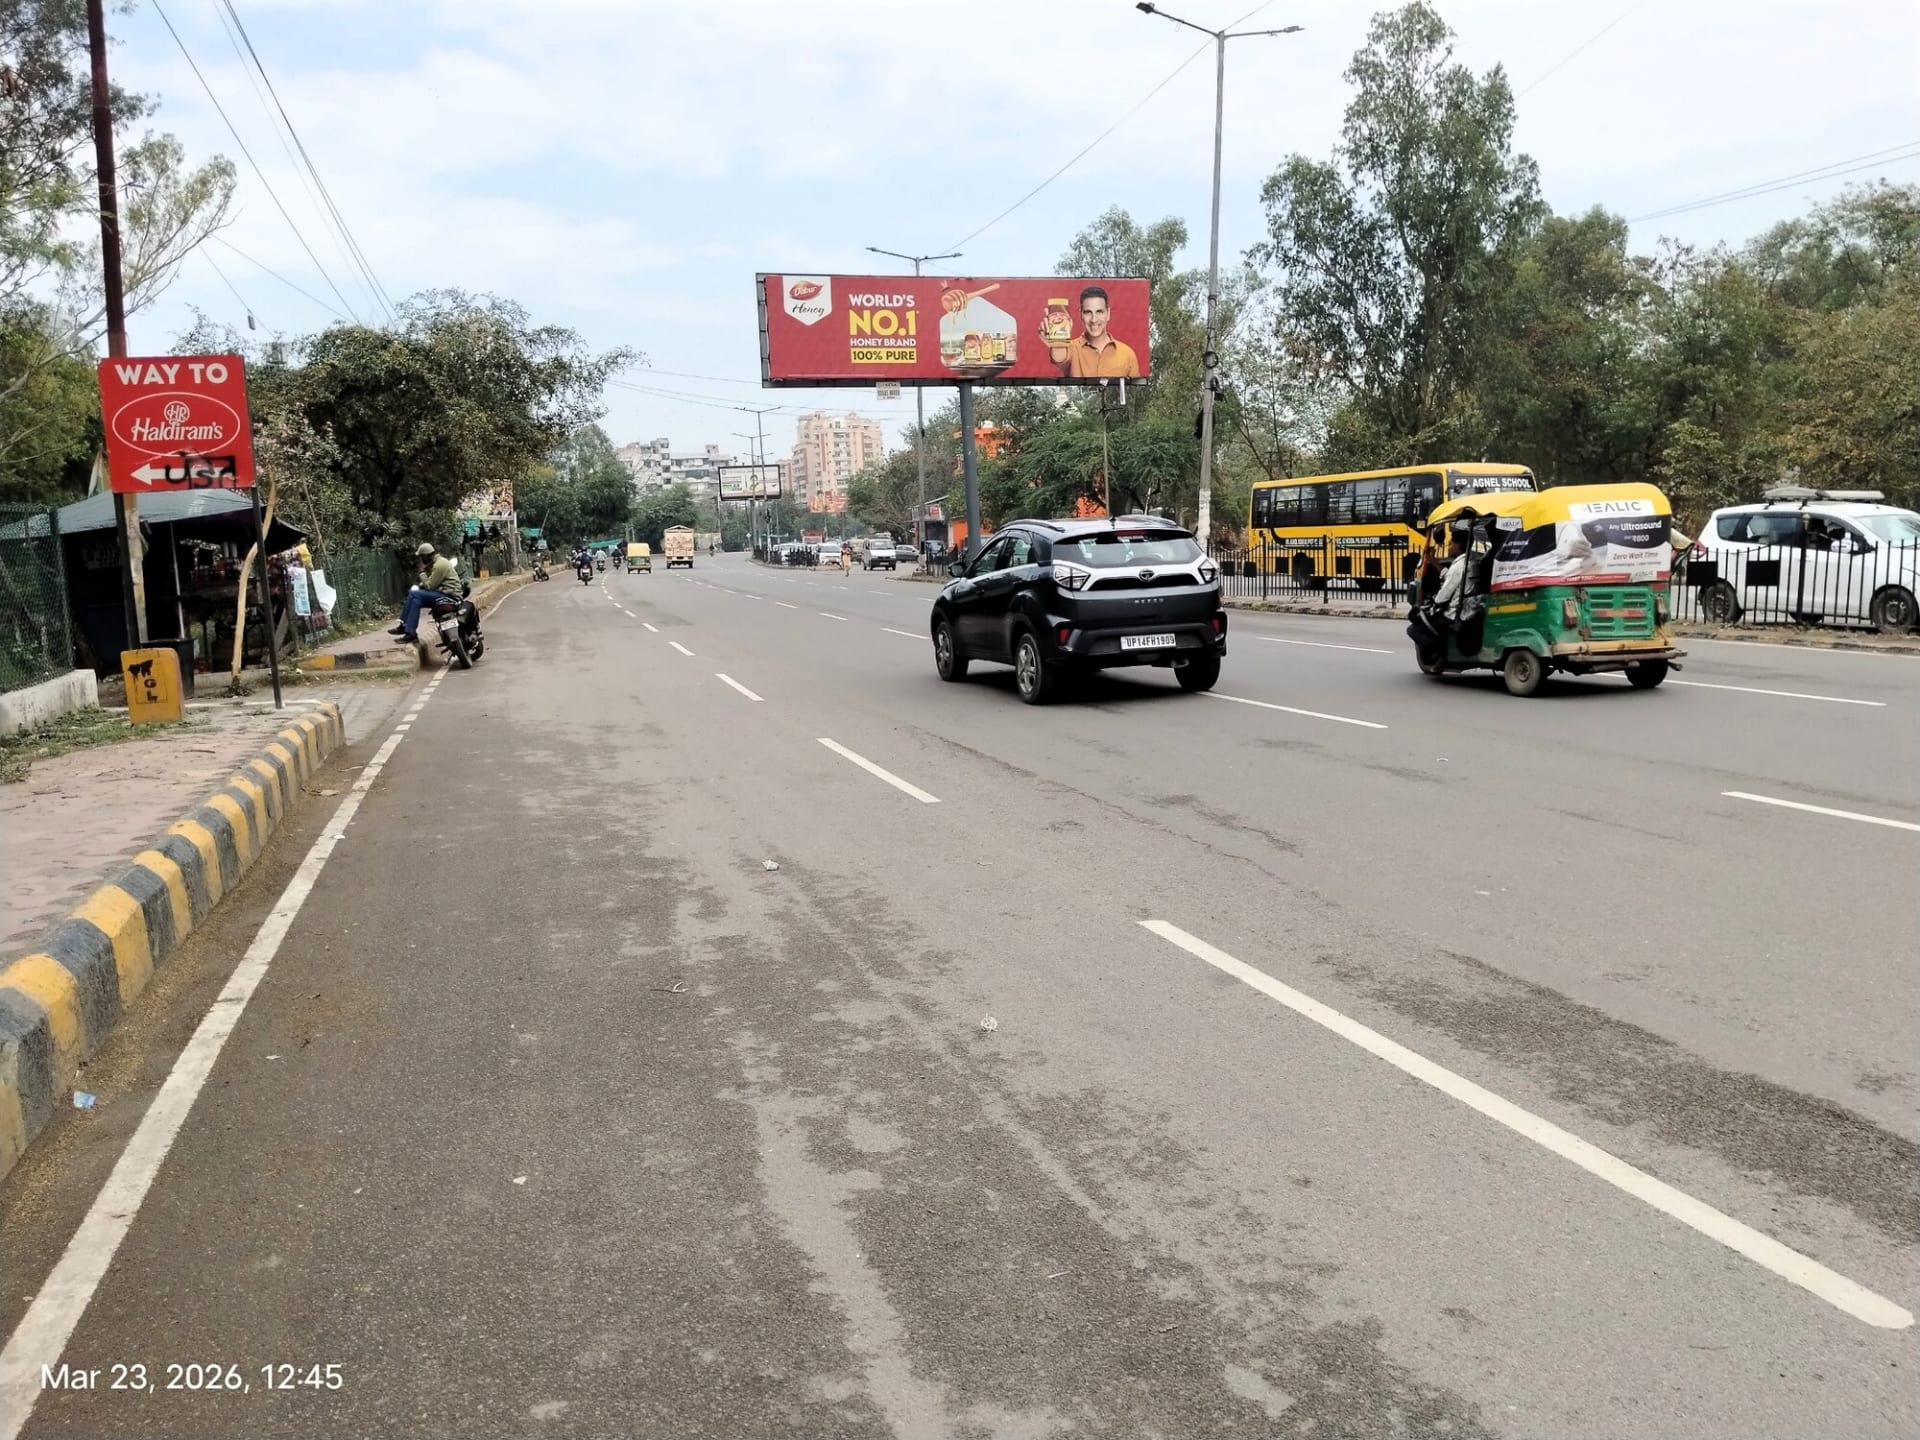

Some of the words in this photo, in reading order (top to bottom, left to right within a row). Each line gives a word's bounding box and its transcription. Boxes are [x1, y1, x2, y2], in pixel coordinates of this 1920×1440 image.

[794, 286, 817, 297] Dabur
[848, 294, 915, 308] WORLD'S
[792, 302, 825, 316] Honey
[849, 309, 917, 336] NO.1
[850, 338, 882, 347] HONEY
[884, 338, 917, 347] BRAND
[852, 350, 883, 361] 100%
[886, 350, 916, 361] PURE
[114, 363, 181, 386] WAY
[188, 362, 229, 385] TO
[131, 418, 223, 442] Haldiram's
[1472, 477, 1501, 489] AGNEL
[1502, 477, 1532, 490] SCHOOL
[1620, 519, 1661, 532] Ultrasound
[1629, 552, 1643, 560] Wait
